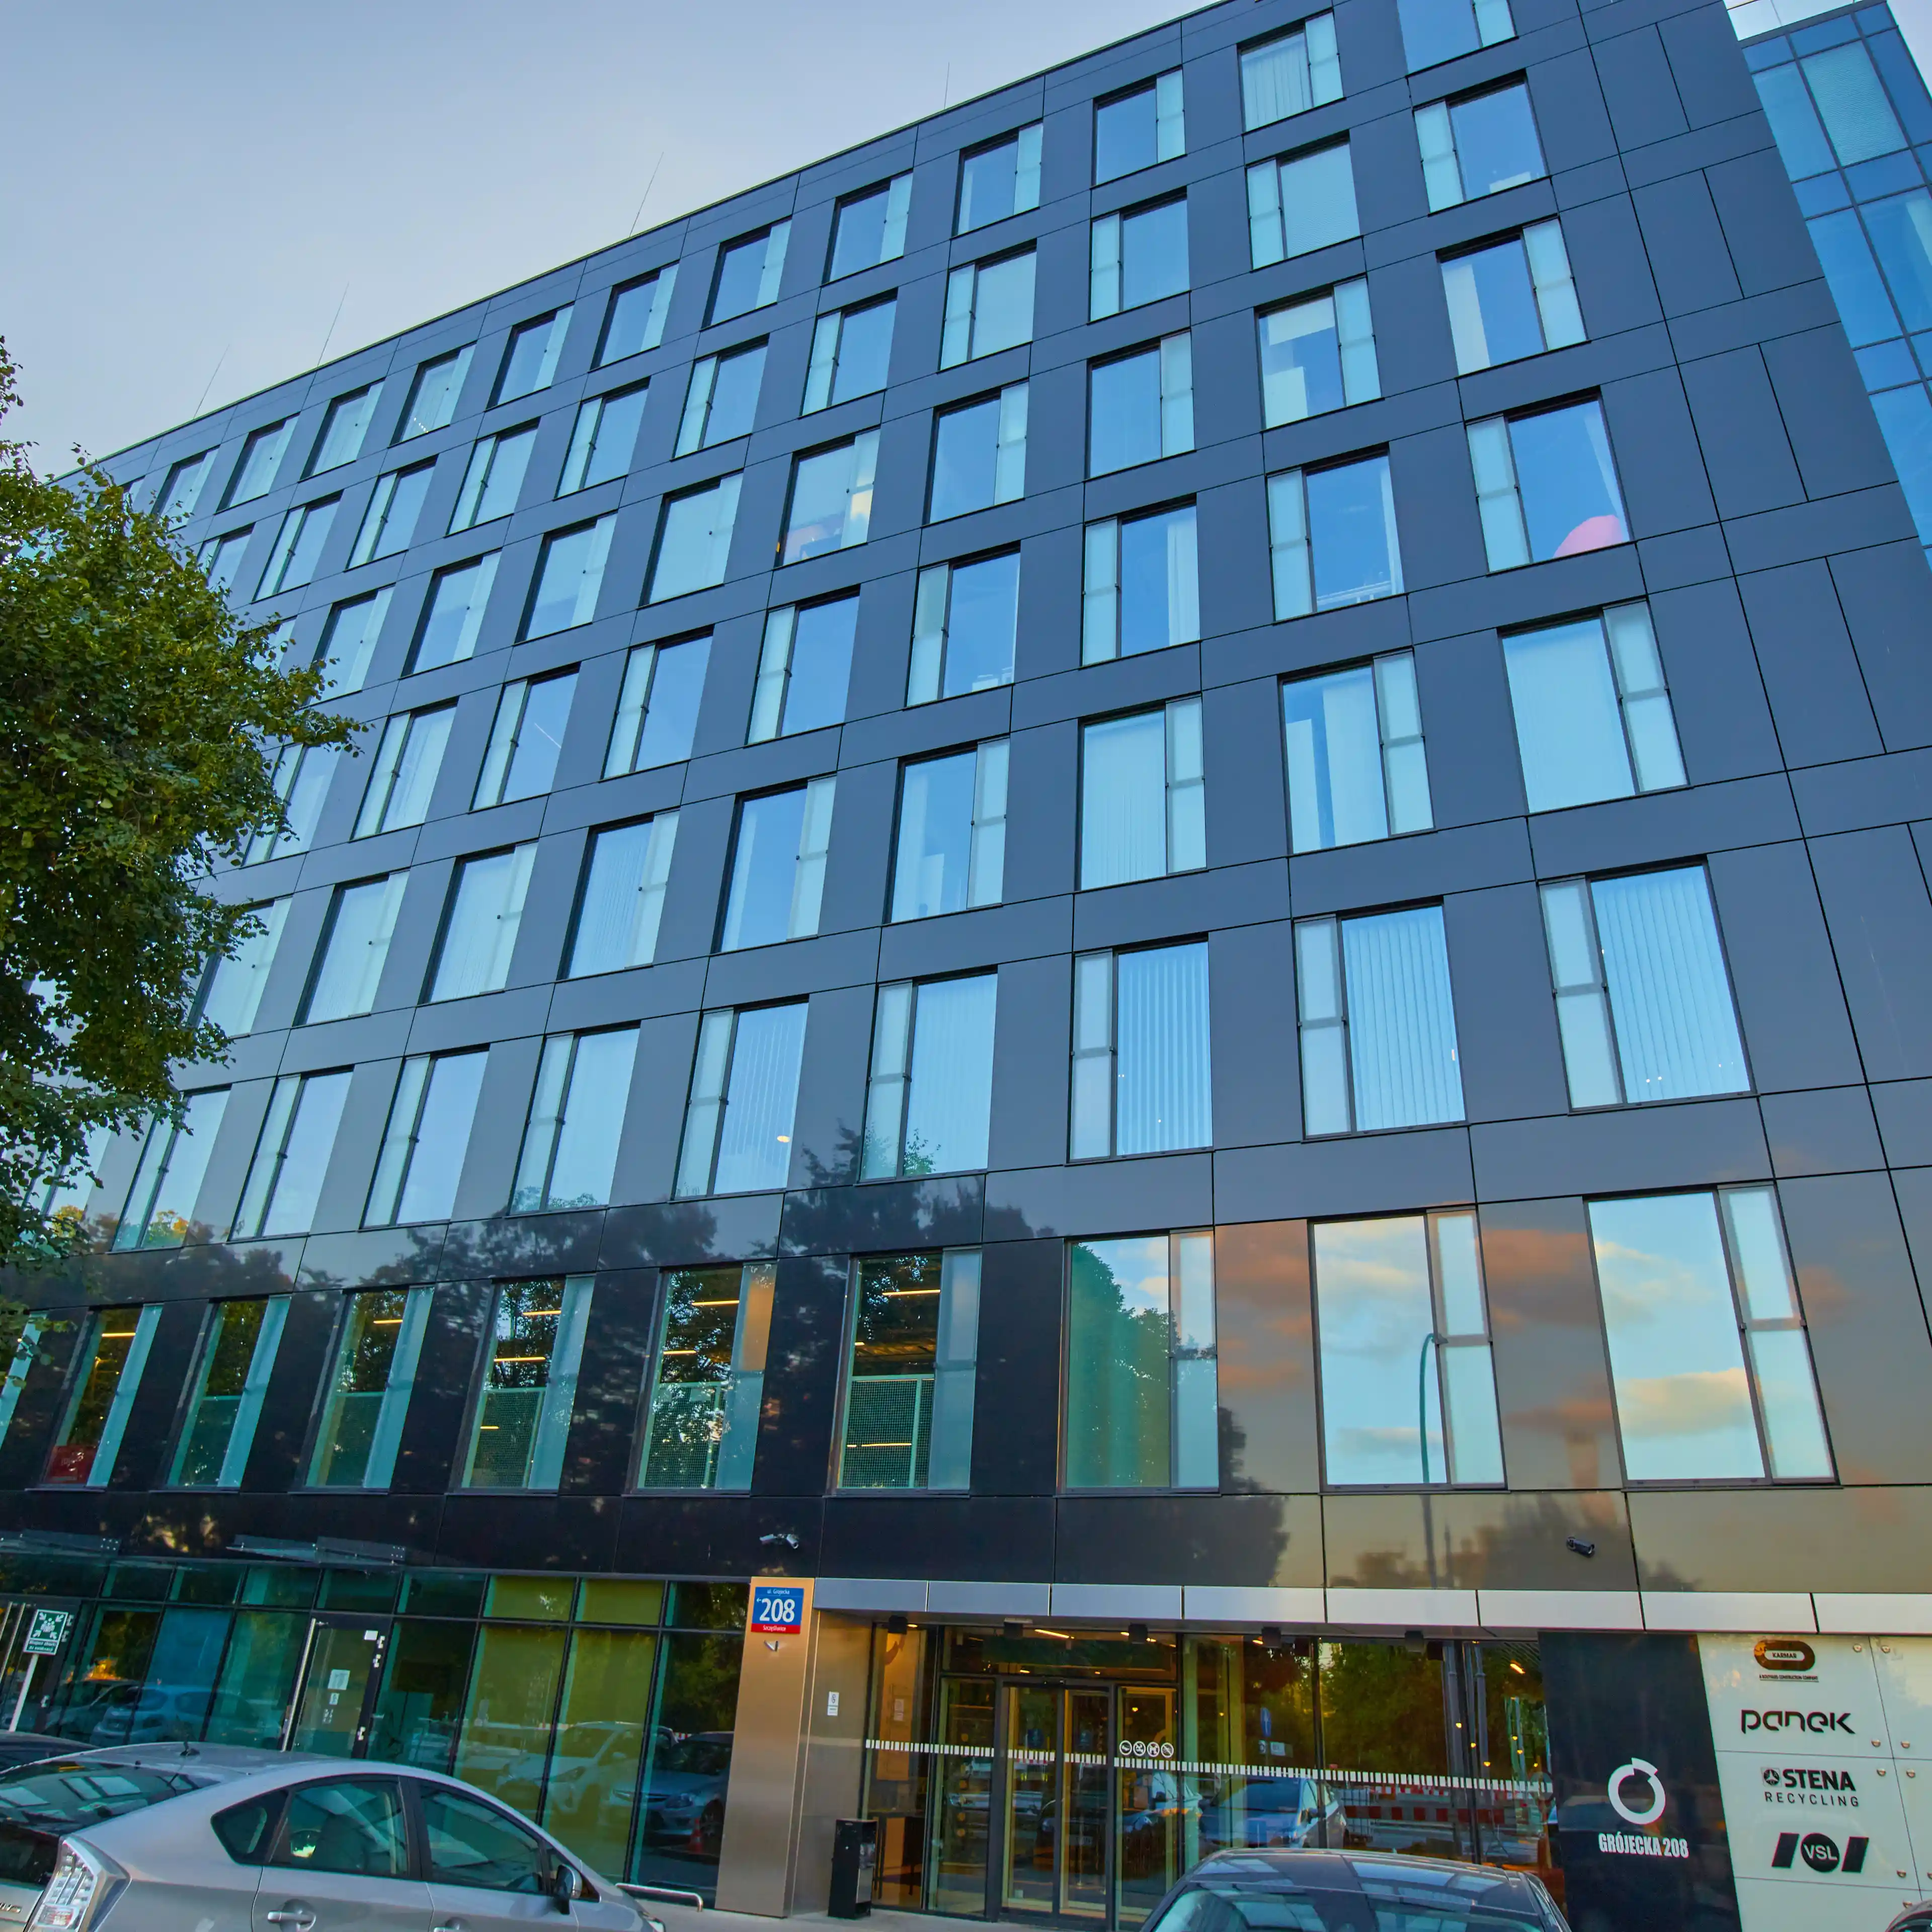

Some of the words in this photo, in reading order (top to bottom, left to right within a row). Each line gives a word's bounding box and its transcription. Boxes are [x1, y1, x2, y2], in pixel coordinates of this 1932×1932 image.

[759, 1598, 795, 1623] 208
[1741, 1709, 1856, 1734] panek
[1783, 1768, 1857, 1792] STENA
[1764, 1791, 1859, 1807] RECYCLING
[1598, 1830, 1662, 1856] GRÓJECKA
[1662, 1837, 1689, 1858] 208
[1803, 1843, 1838, 1861] VSL
